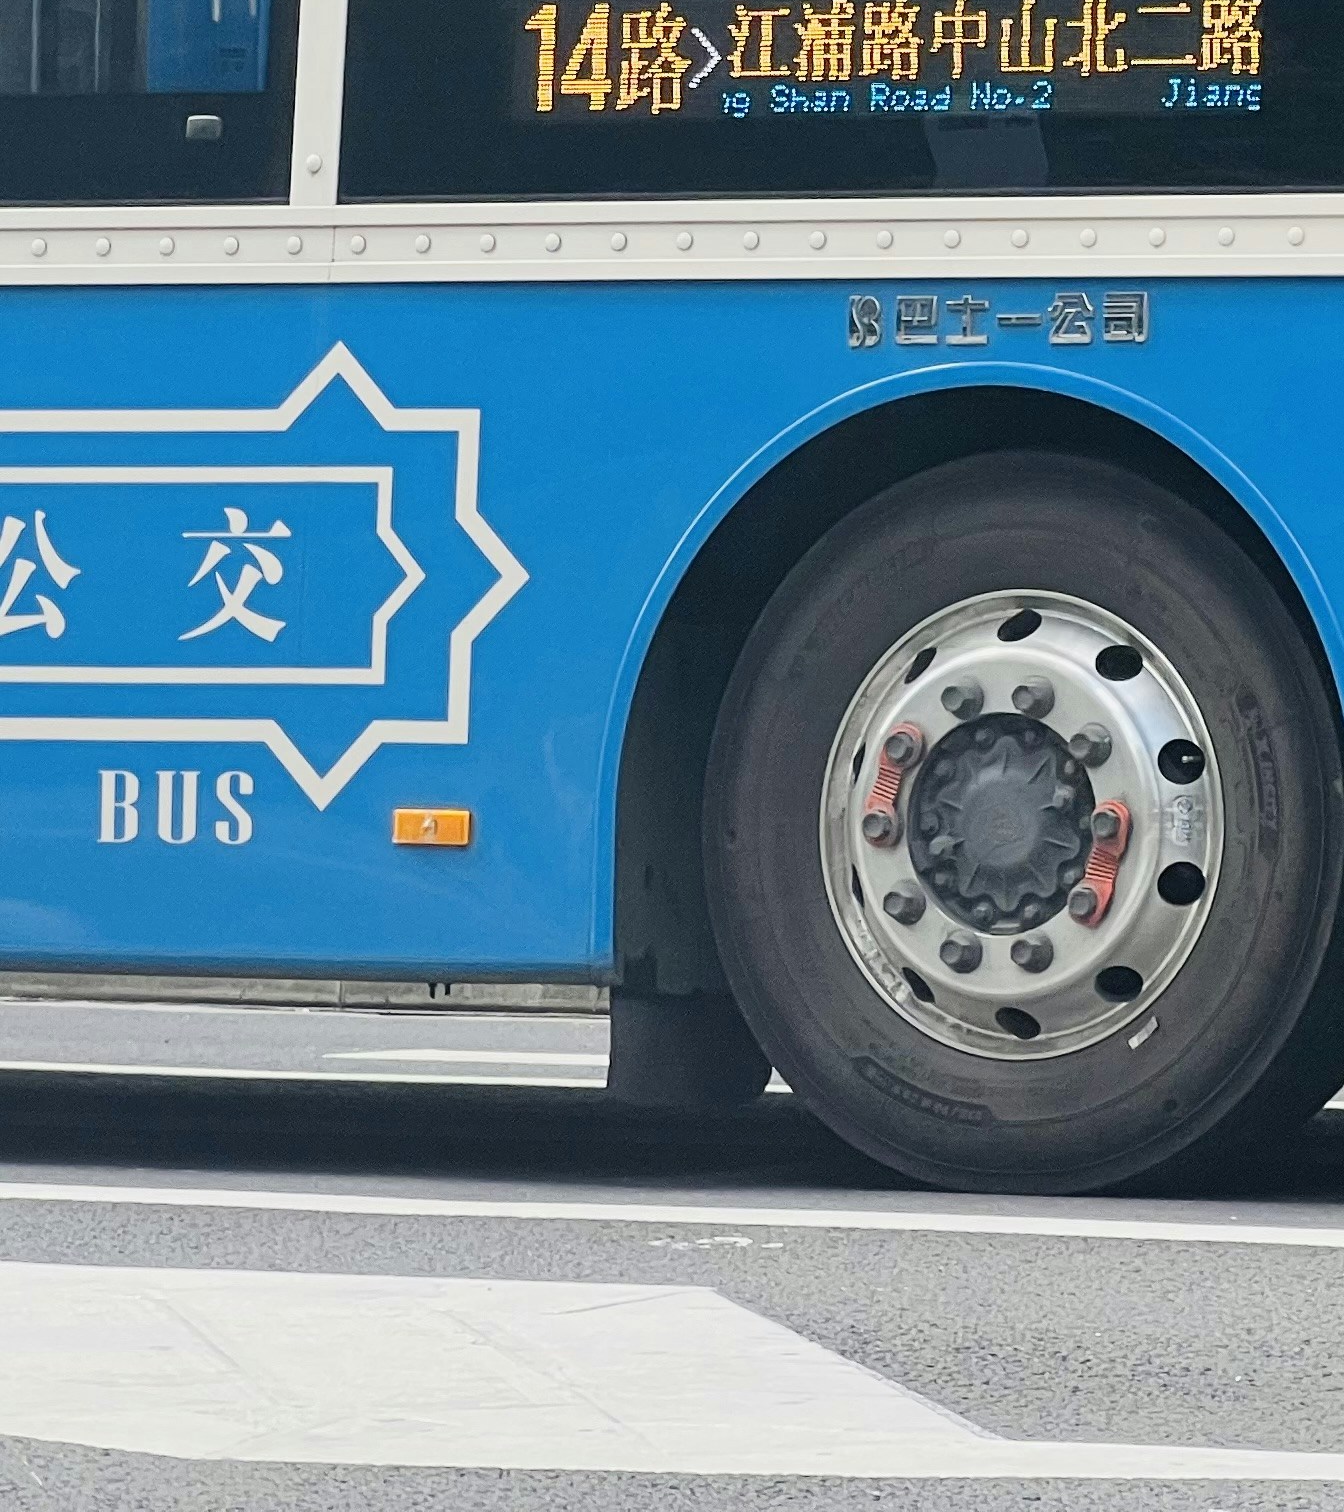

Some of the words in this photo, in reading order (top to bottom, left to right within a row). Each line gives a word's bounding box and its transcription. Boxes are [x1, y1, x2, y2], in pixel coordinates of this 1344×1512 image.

[769, 84, 852, 113] Shan
[869, 81, 952, 113] Road
[894, 291, 1151, 347] 巴士一公司
[97, 769, 255, 846] BUS
